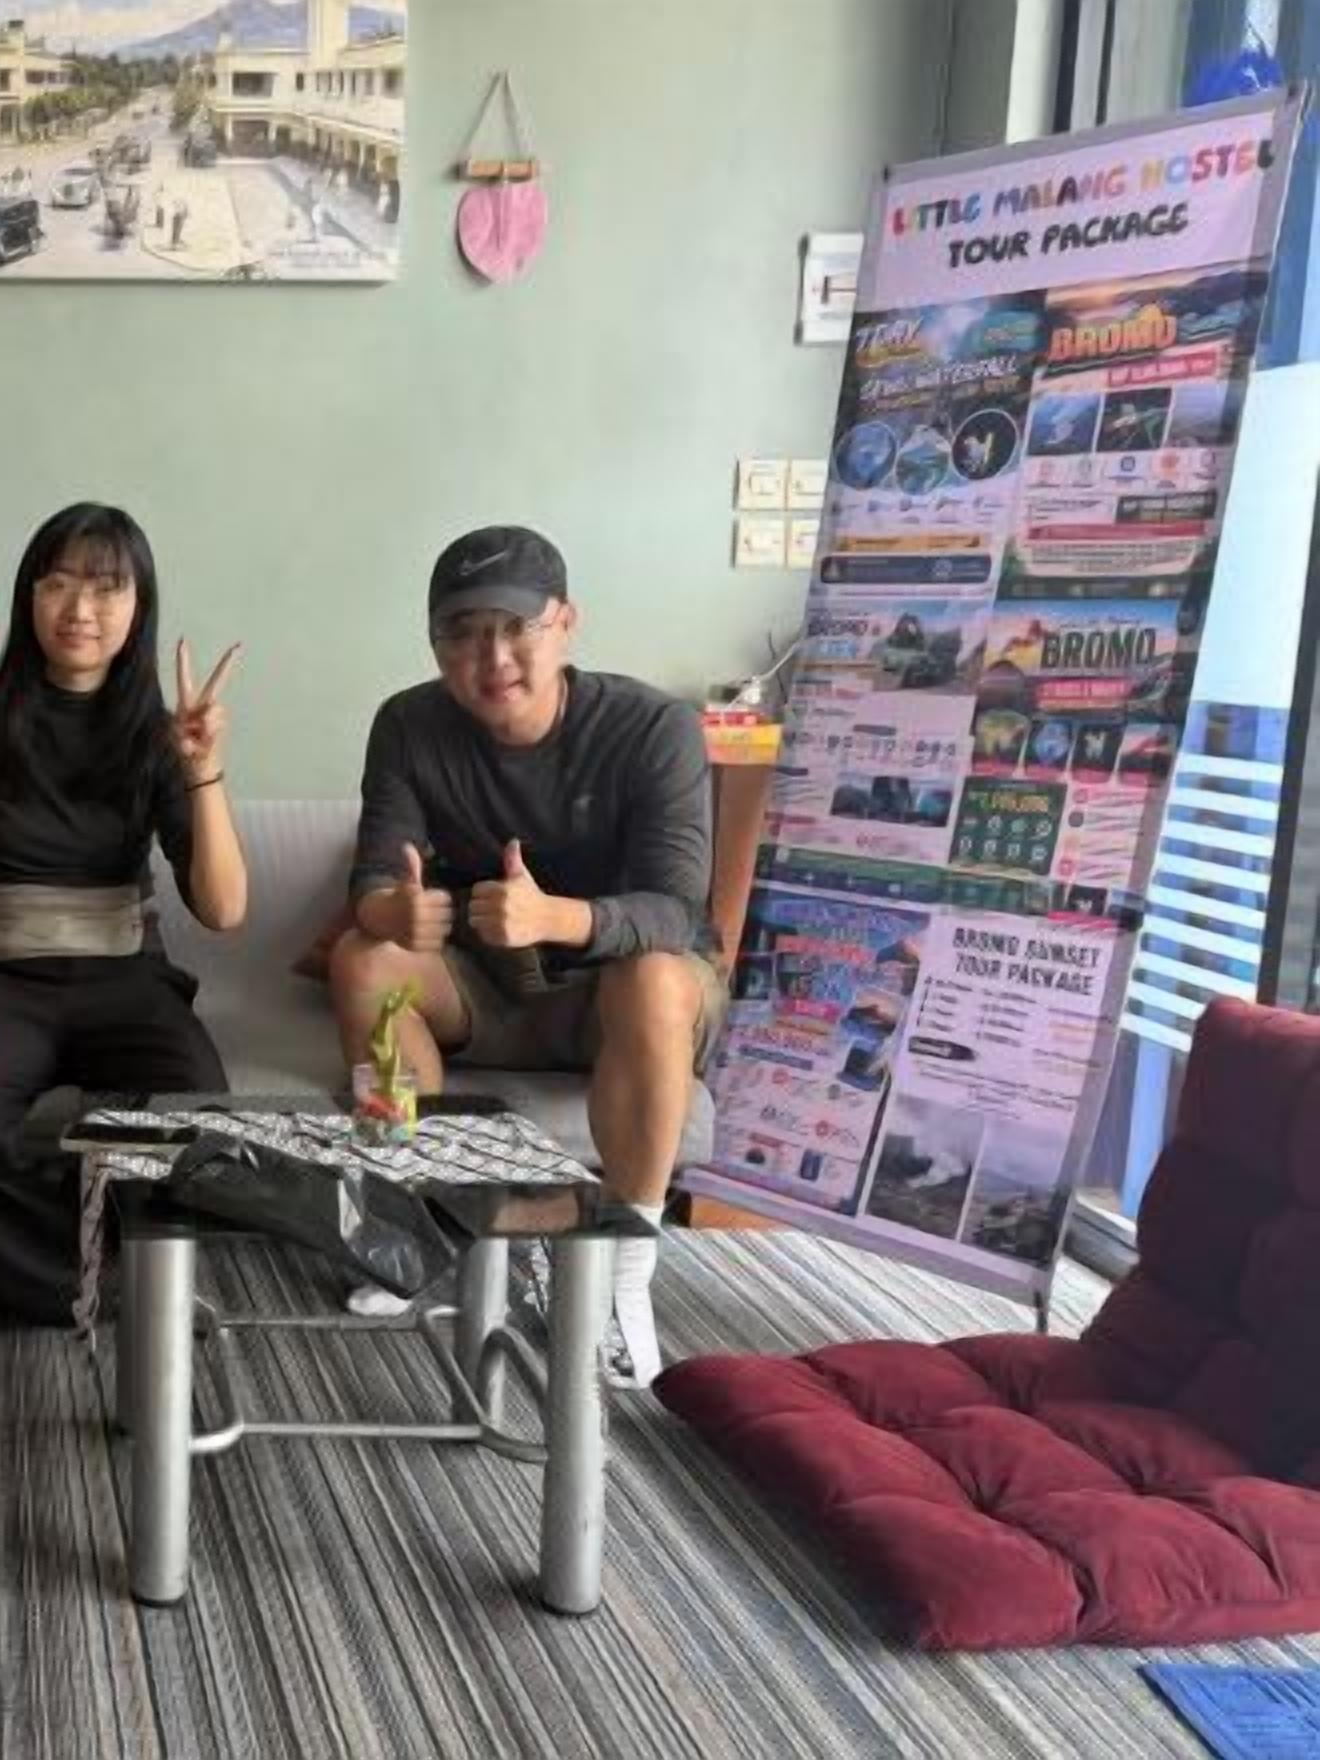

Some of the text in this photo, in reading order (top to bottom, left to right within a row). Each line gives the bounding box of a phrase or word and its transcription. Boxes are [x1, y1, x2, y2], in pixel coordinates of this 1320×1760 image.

[892, 139, 1275, 236] LITTLE MALANG HOSTEL
[948, 202, 1189, 268] TOUR PACKAGE
[1048, 306, 1177, 361] BROMO
[1041, 627, 1157, 669] BROMO
[953, 927, 1101, 968] BROMO SUNSET
[955, 952, 1095, 996] TOUR PACKAGE
